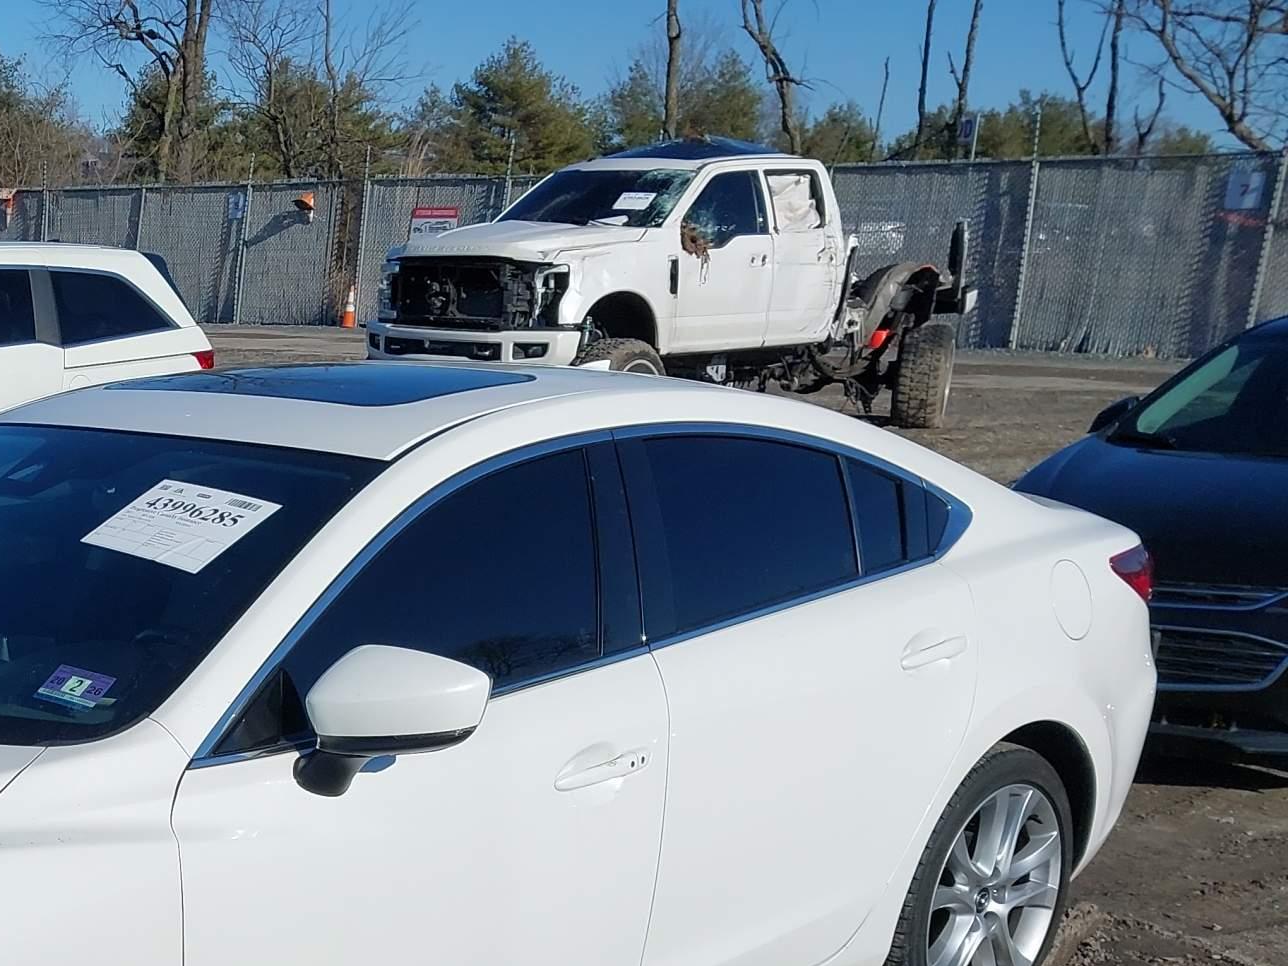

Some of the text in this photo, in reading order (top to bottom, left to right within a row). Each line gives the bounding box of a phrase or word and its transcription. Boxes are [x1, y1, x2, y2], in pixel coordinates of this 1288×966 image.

[145, 496, 246, 528] 43996285
[69, 679, 84, 692] 2
[86, 686, 104, 696] 26
